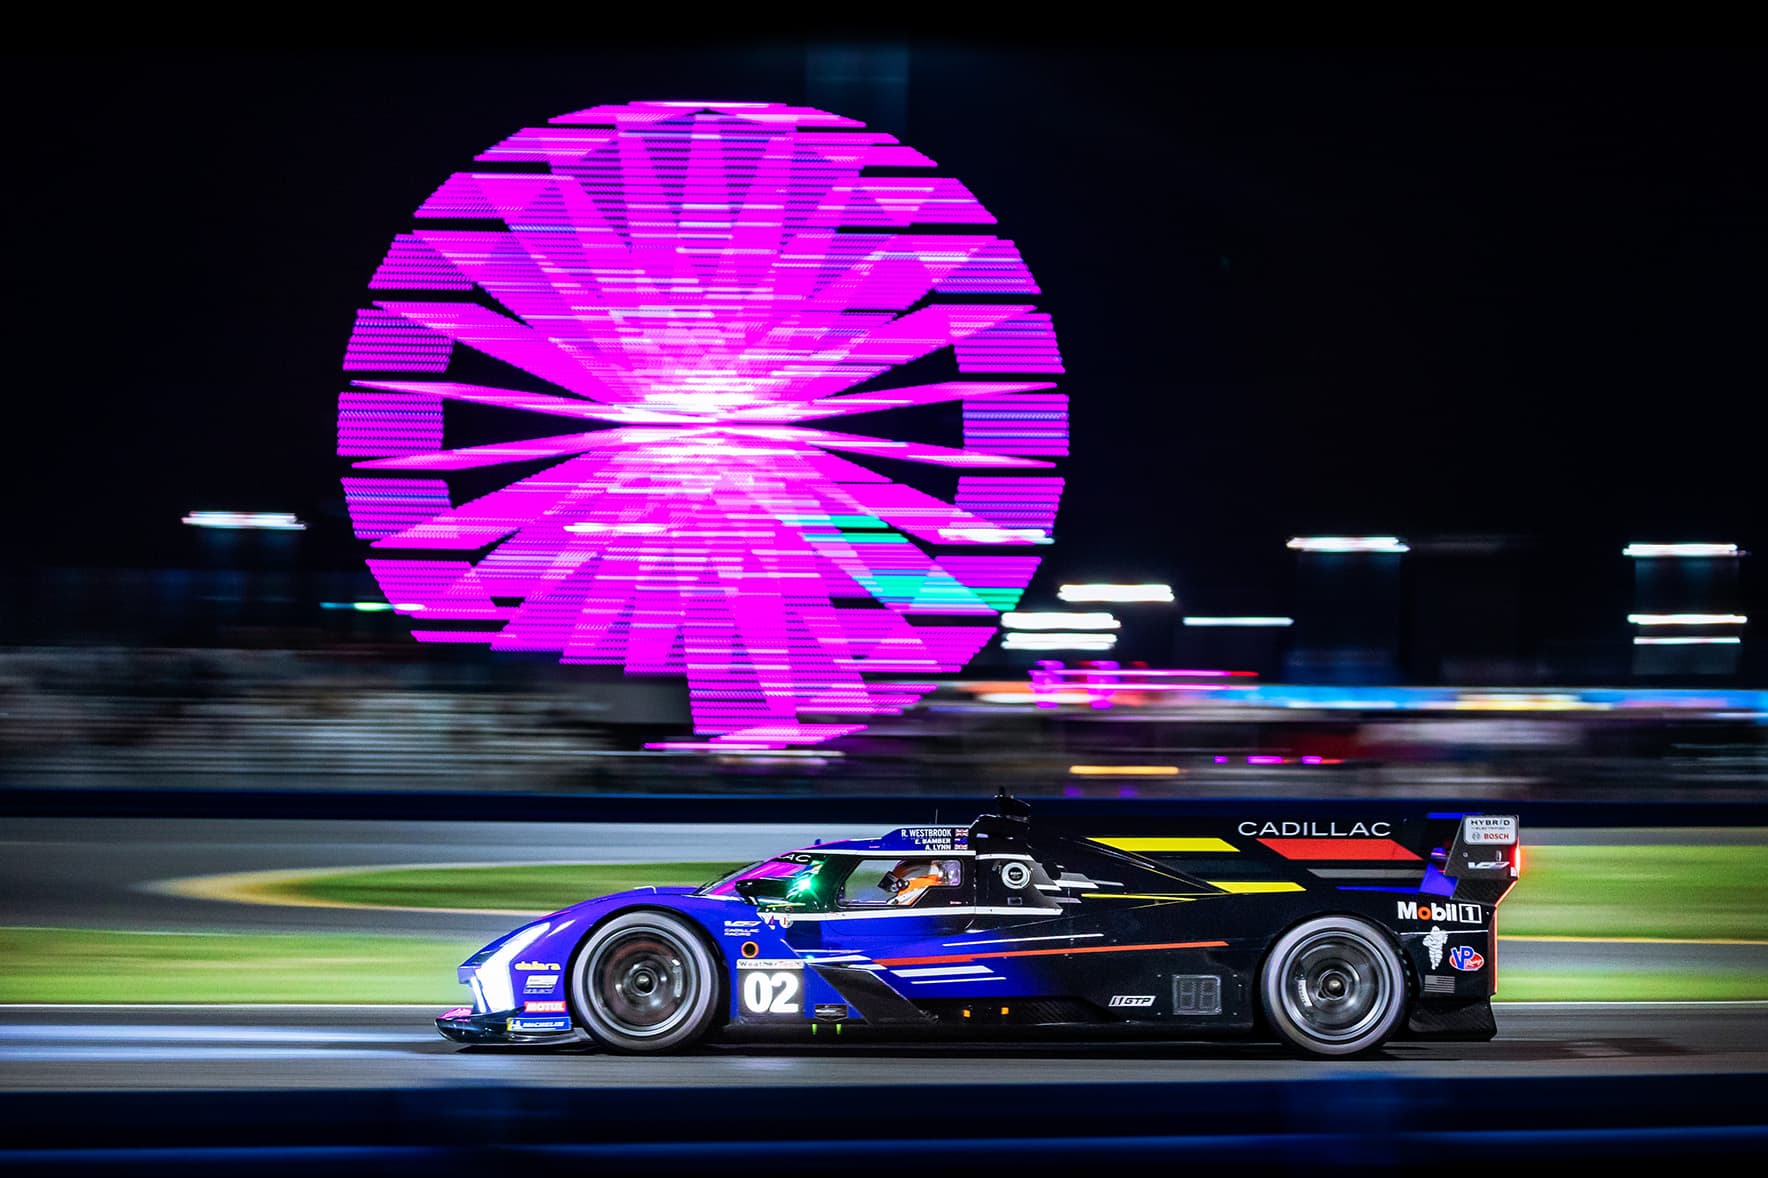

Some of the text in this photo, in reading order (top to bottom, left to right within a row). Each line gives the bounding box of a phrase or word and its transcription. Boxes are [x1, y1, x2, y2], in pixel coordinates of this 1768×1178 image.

[909, 829, 952, 837] WESTBROOK
[1238, 821, 1391, 836] CADILLAC
[1397, 901, 1457, 921] Mobil
[1451, 946, 1474, 970] VP
[744, 972, 799, 1013] 02
